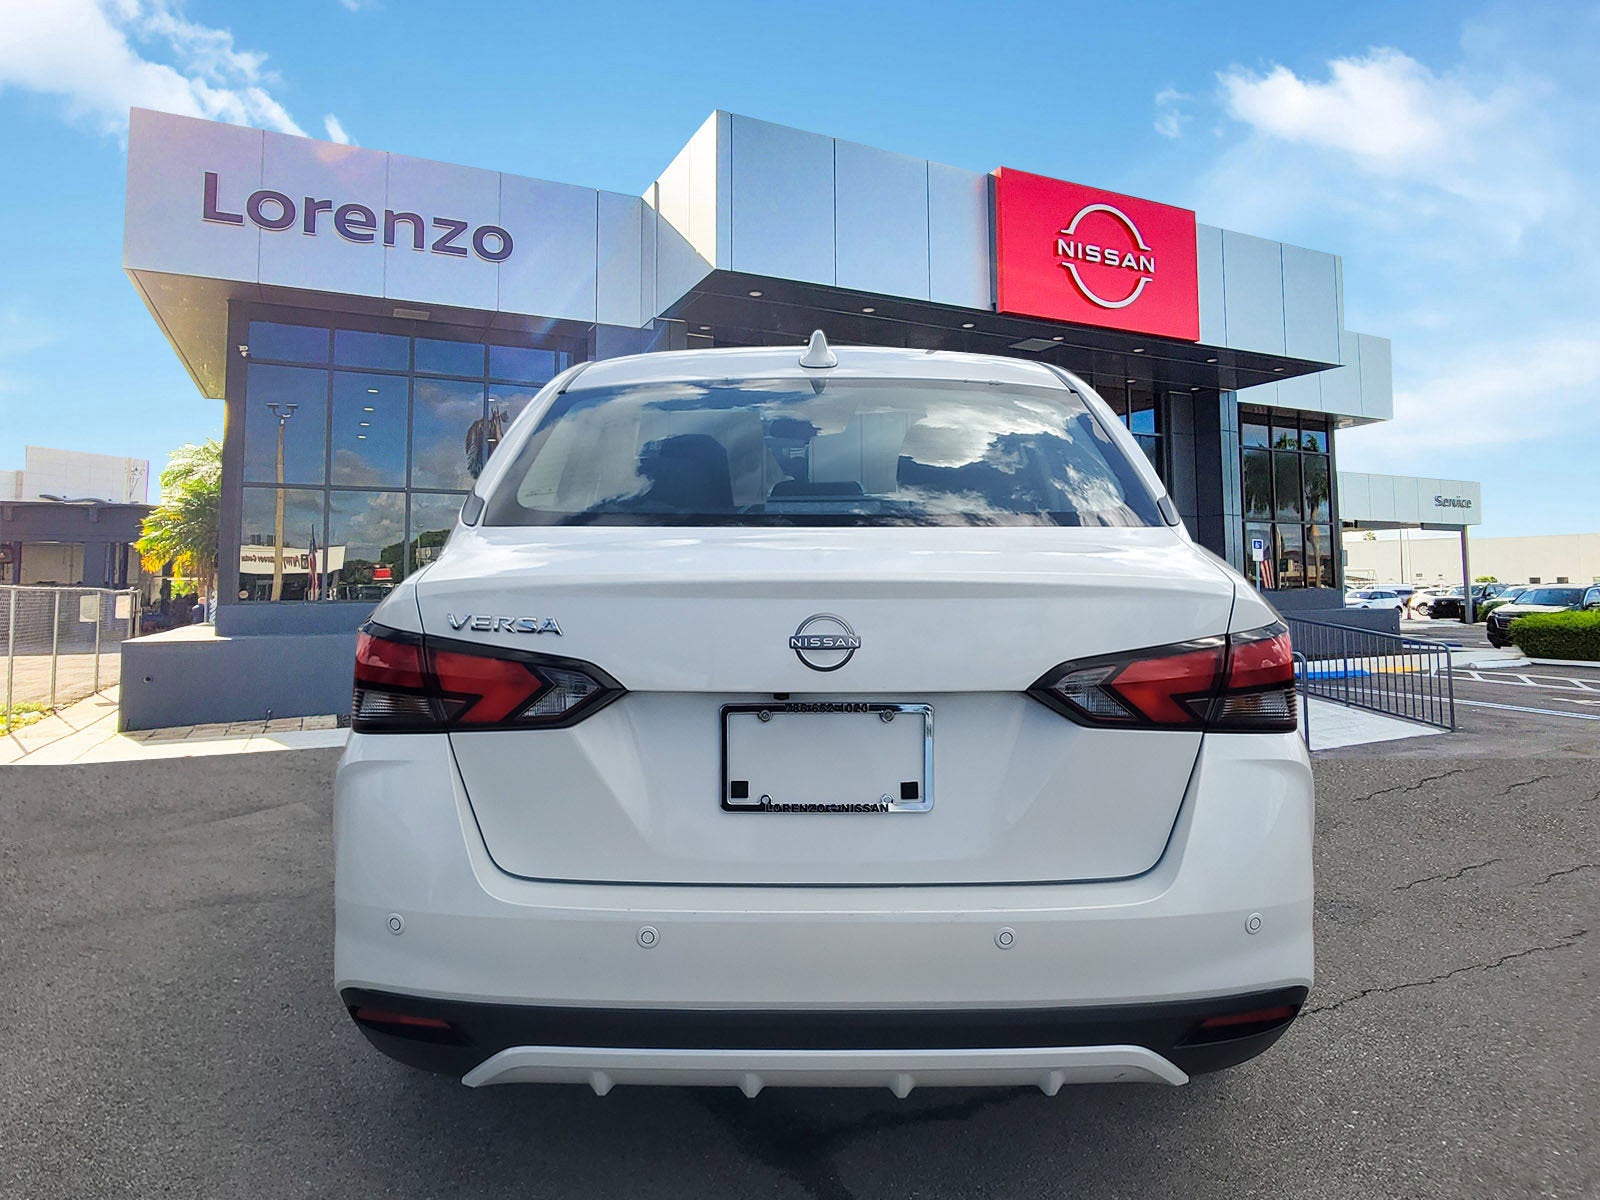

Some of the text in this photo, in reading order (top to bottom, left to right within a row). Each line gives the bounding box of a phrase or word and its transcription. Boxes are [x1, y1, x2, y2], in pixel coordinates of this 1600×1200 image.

[202, 170, 514, 262] Lorenzo
[1057, 238, 1155, 273] NISSAN
[1434, 495, 1472, 508] Service
[447, 612, 563, 636] VERSA
[791, 637, 860, 647] NISSAN
[766, 803, 889, 813] LORENZO NISSAN
